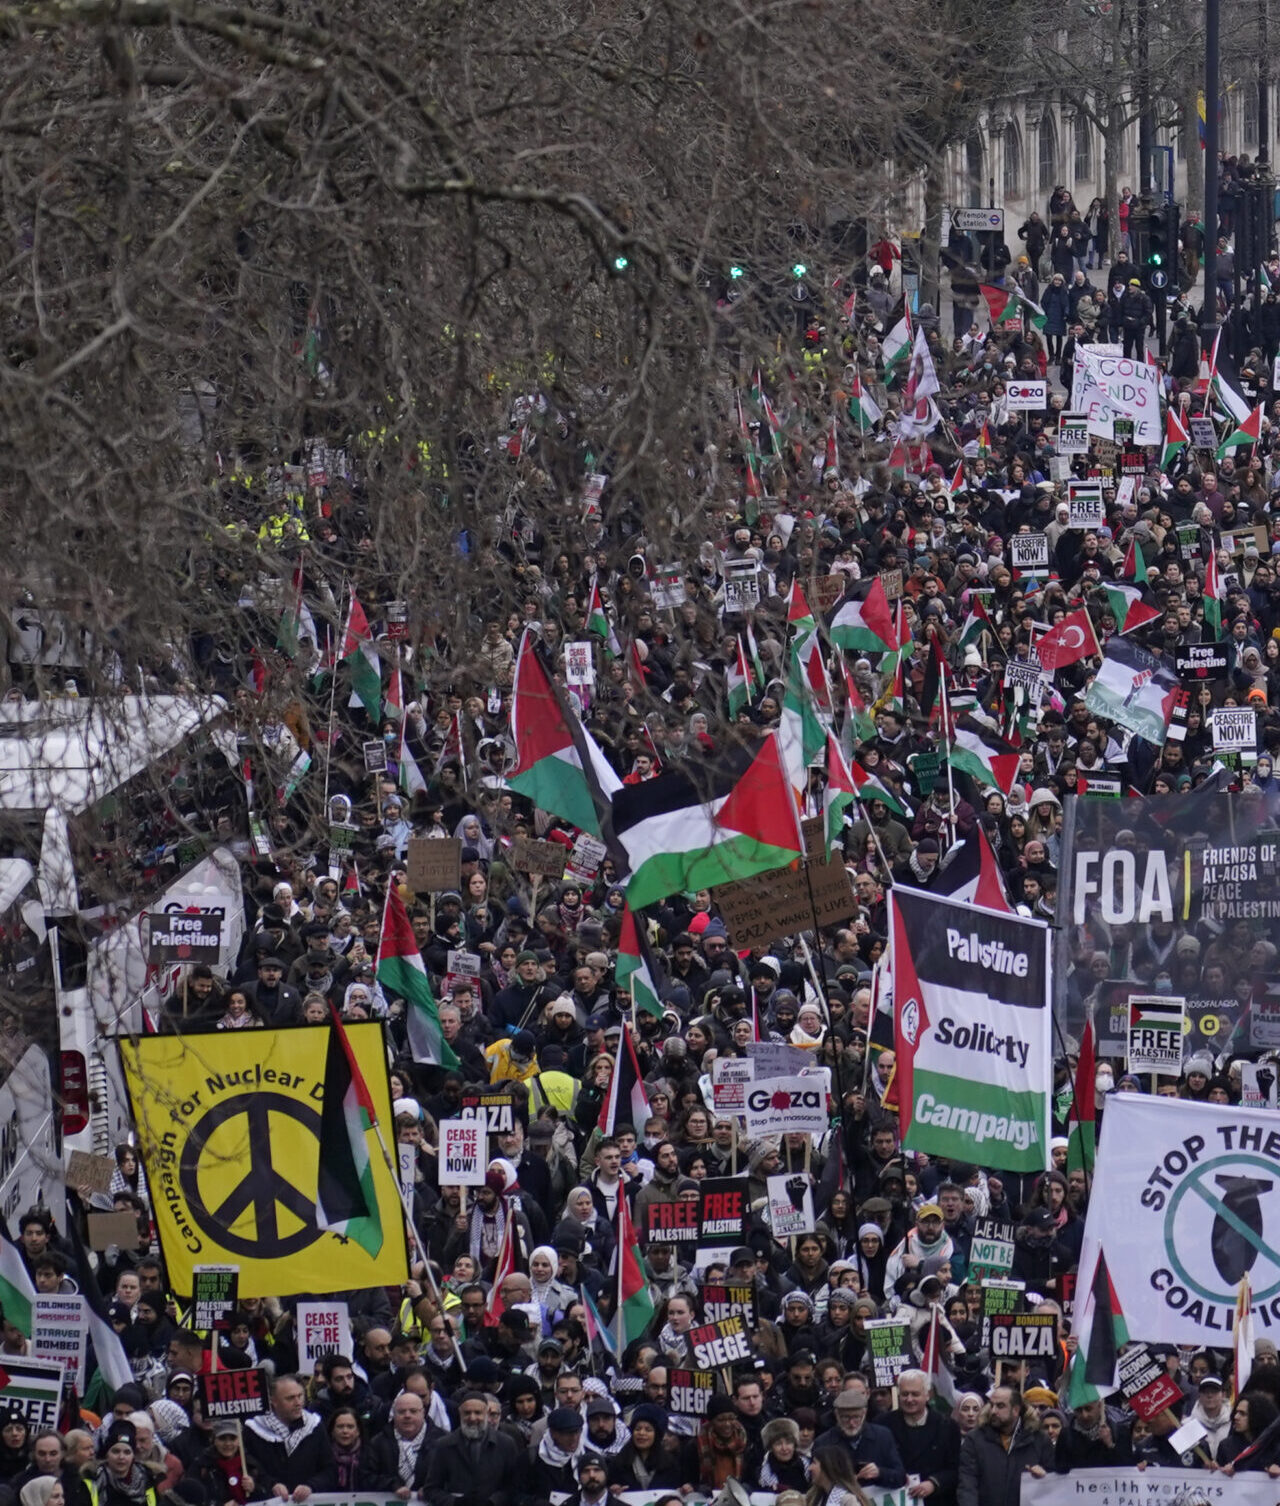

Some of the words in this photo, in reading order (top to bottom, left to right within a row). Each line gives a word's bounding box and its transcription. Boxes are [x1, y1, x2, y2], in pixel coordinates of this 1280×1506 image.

[1060, 429, 1088, 440] FREE
[1121, 454, 1145, 467] FREE
[1070, 501, 1101, 513] FREE
[1176, 657, 1227, 670] Palestine
[1189, 647, 1215, 664] Free
[1214, 713, 1254, 726] CEASEFIRE
[1202, 846, 1257, 866] FRIENDS
[1260, 844, 1277, 862] OF
[1202, 864, 1258, 885] AL-AQSA
[1073, 849, 1174, 926] FOA
[1201, 883, 1242, 902] PEACE
[1200, 901, 1217, 919] IN
[169, 916, 203, 931] Free
[152, 931, 219, 947] Palestine
[1130, 1029, 1181, 1049] FREE
[1129, 1048, 1181, 1060] PALESTINE
[169, 1091, 203, 1125] for
[205, 1064, 304, 1095] Nuclear
[750, 1119, 768, 1127] Stop
[446, 1129, 478, 1142] CEASE
[446, 1158, 478, 1173] NOW!
[1140, 1134, 1206, 1212] STOP
[159, 1131, 203, 1254] Campaign
[703, 1192, 743, 1220] FREE
[648, 1202, 699, 1229] FREE
[648, 1227, 699, 1242] PALESTINE
[702, 1217, 743, 1235] PALESTINE
[974, 1219, 994, 1239] WE
[993, 1223, 1015, 1243] WILL
[971, 1242, 999, 1261] NOT
[999, 1246, 1015, 1265] BE
[728, 1287, 752, 1304] THE
[195, 1301, 234, 1312] PALESTINE
[703, 1302, 754, 1328] SIEGE
[194, 1320, 214, 1330] FREE
[305, 1311, 340, 1327] CEASE
[1016, 1316, 1054, 1327] BOMBING
[36, 1327, 81, 1339] STARVED
[690, 1324, 717, 1347] END
[716, 1316, 744, 1338] THE
[36, 1338, 80, 1351] BOMBED
[693, 1331, 751, 1369] SIEGE
[992, 1327, 1055, 1357] GAZA
[873, 1354, 911, 1367] PALESTINE
[693, 1371, 713, 1389] THE
[874, 1366, 892, 1377] WILL
[203, 1367, 260, 1403] FREE
[875, 1376, 895, 1388] FREE
[207, 1397, 264, 1416] PALESTINE
